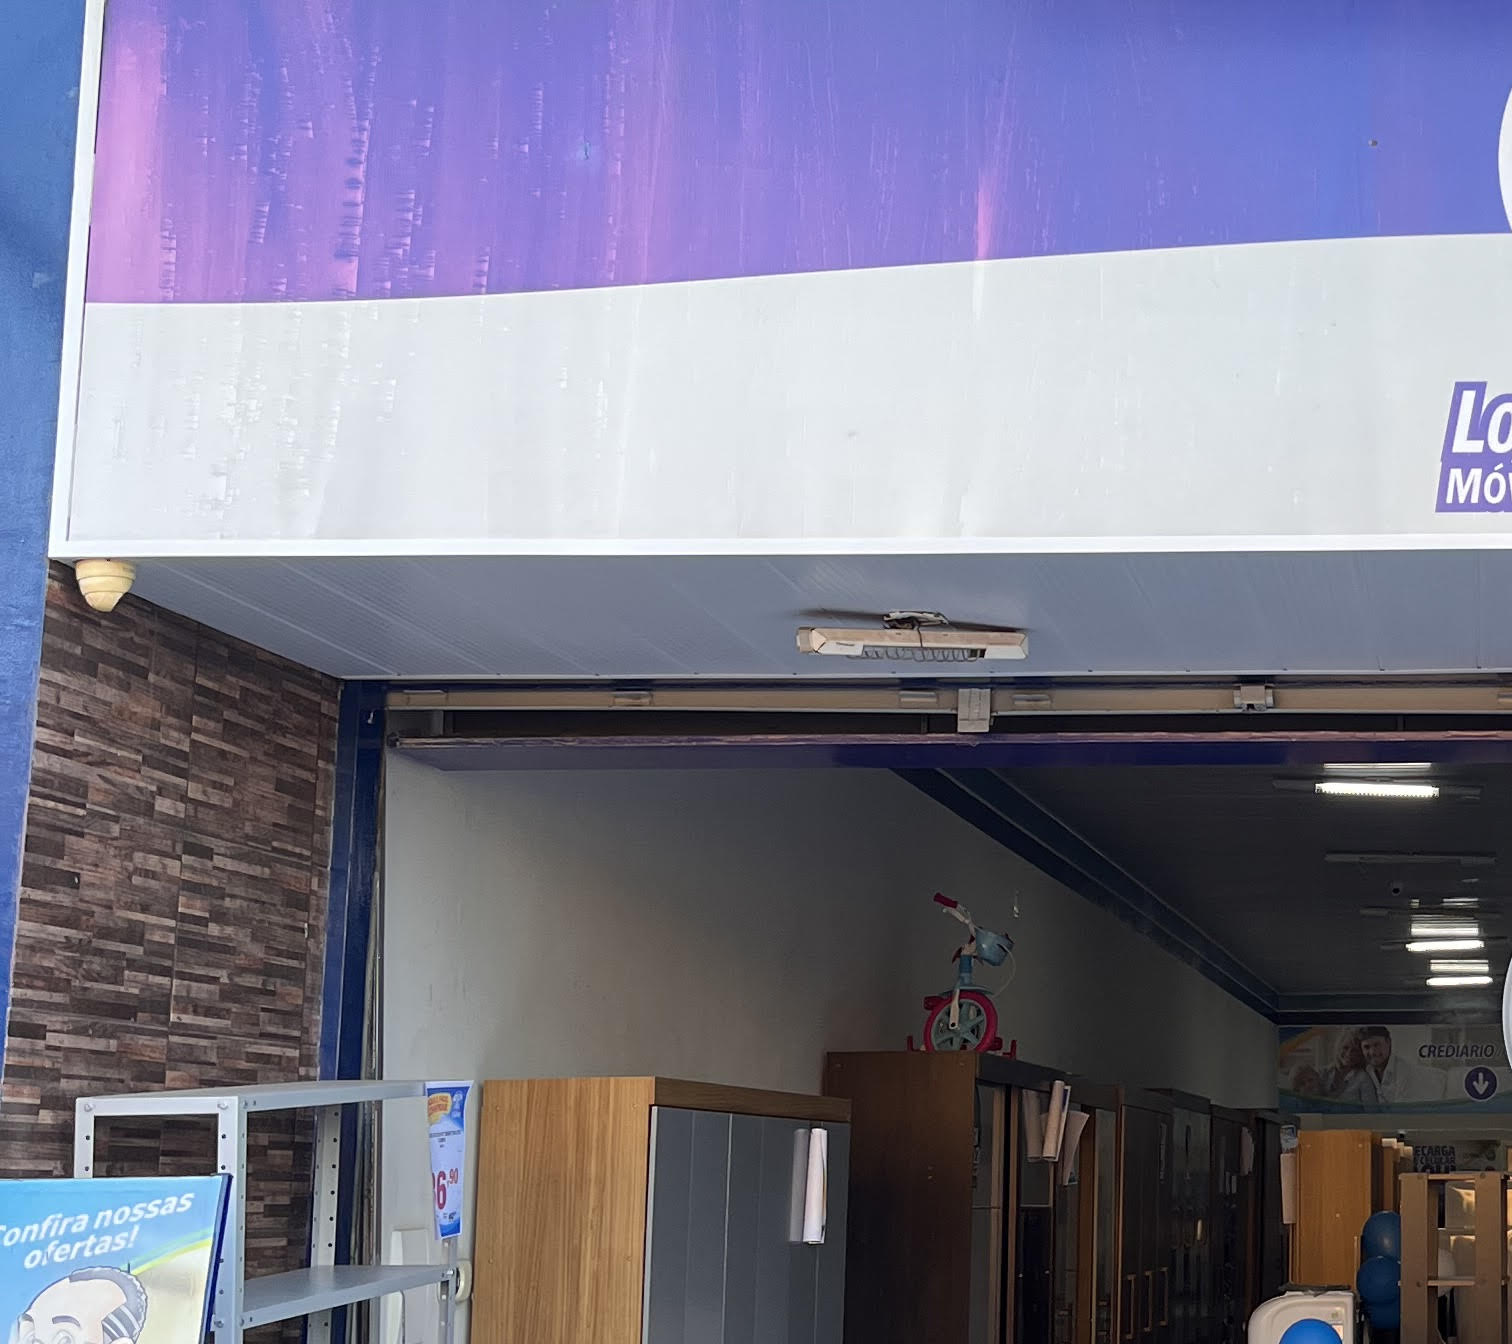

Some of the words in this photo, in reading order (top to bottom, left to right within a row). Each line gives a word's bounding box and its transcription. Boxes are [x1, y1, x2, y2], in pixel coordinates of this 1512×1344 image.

[1418, 1044, 1496, 1058] CREDIARIO
[1415, 1145, 1457, 1156] ECARGA
[93, 1192, 196, 1230] nossas
[24, 1224, 141, 1270] ofertas!
